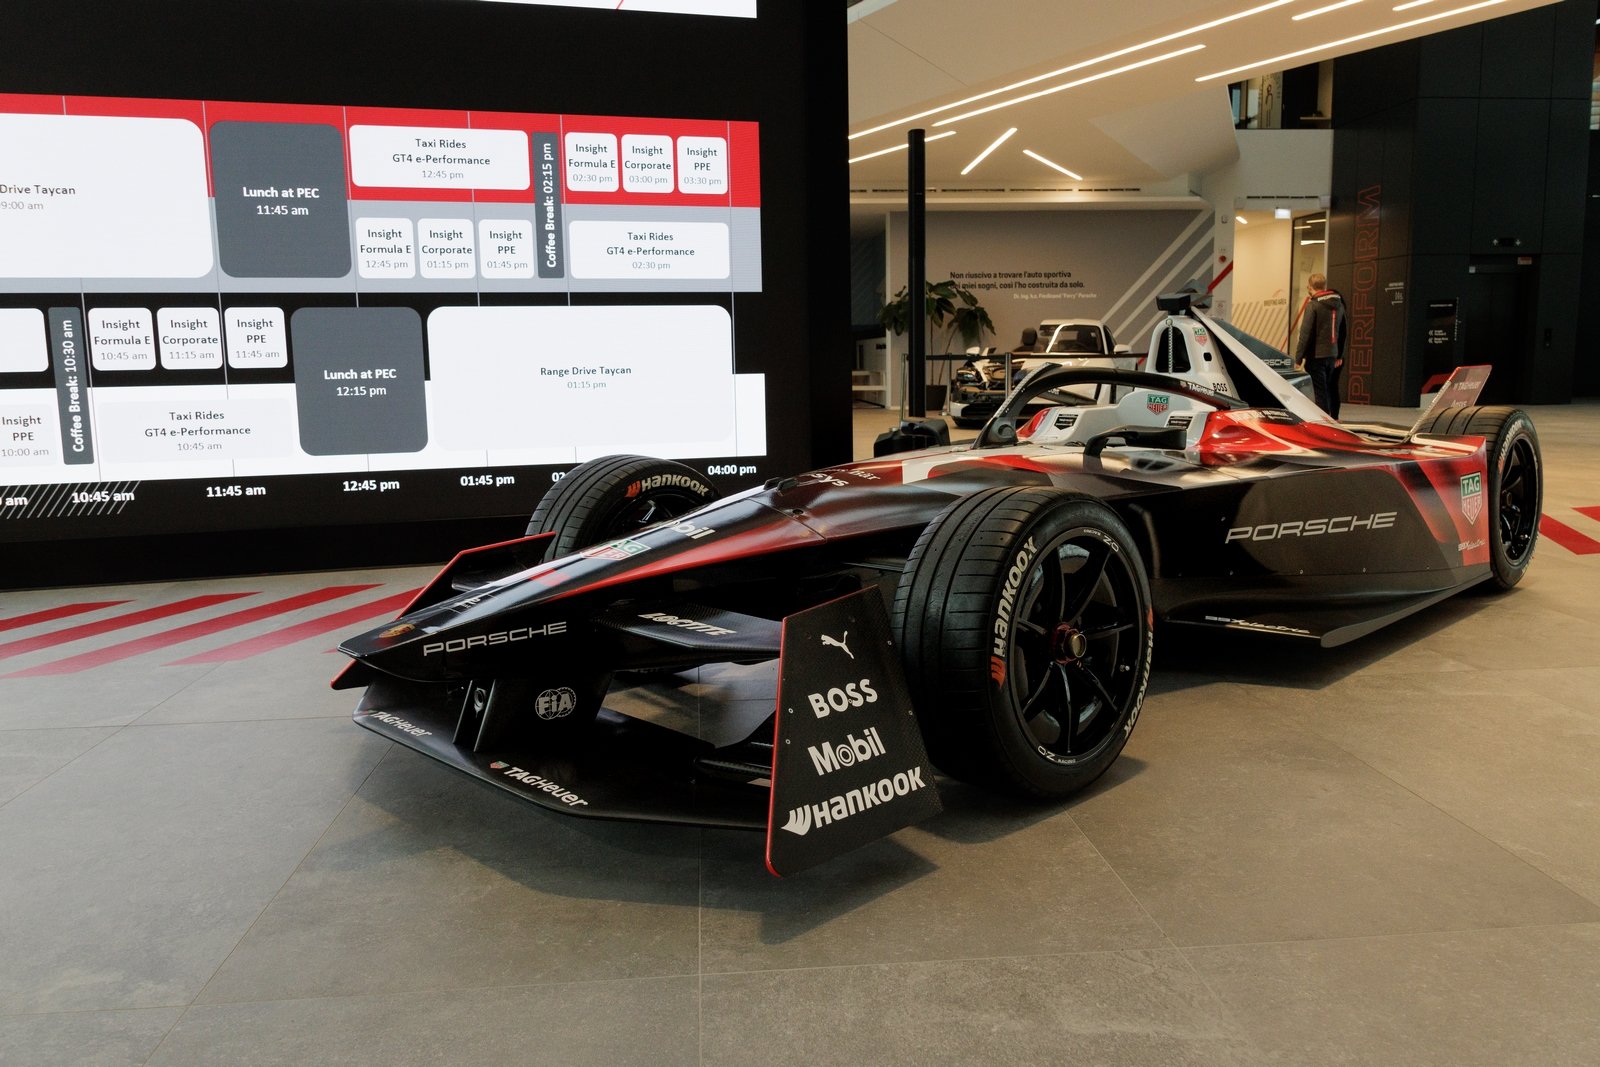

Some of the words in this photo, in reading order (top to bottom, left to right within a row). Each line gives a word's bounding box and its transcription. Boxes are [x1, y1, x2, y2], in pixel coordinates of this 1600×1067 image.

[416, 139, 436, 147] Taxi
[440, 140, 466, 148] Rides
[544, 143, 552, 160] pm
[576, 144, 607, 154] Insight
[633, 146, 663, 156] Insight
[687, 148, 717, 158] Insight
[393, 154, 412, 162] GT4
[416, 155, 490, 164] e-Performance
[569, 159, 607, 168] Formula
[611, 160, 615, 168] E
[625, 161, 671, 171] Corporate
[542, 164, 553, 193] 02:15
[0, 185, 30, 194] Drive
[33, 184, 76, 197] Taycan
[243, 187, 278, 197] Lunch
[282, 188, 294, 197] at
[297, 188, 319, 198] PEC
[257, 205, 288, 215] 11:45
[544, 196, 555, 230] Break:
[368, 229, 401, 240] Insight
[430, 230, 463, 240] Insight
[490, 231, 521, 241] Insight
[628, 232, 646, 240] Taxi
[361, 245, 402, 253] Formula
[406, 245, 411, 253] E
[422, 246, 472, 255] Corporate
[498, 246, 515, 254] PPE
[546, 230, 556, 267] Coffee
[607, 247, 624, 255] GT4
[628, 247, 694, 255] e-Performance
[655, 262, 670, 270] pm
[1043, 271, 1072, 279] sportiva
[1027, 281, 1058, 289] costruita
[1059, 281, 1068, 289] da
[1348, 184, 1381, 406] PERFORM
[63, 320, 73, 338] am
[102, 320, 140, 331] Insight
[171, 319, 207, 330] Insight
[237, 319, 273, 330] Insight
[94, 336, 141, 345] Formula
[146, 336, 150, 344] E
[163, 336, 218, 346] Corporate
[247, 335, 265, 343] PPE
[63, 341, 76, 372] 10:30
[101, 352, 128, 360] 10:45
[236, 350, 261, 358] 11:45
[324, 369, 357, 379] Lunch
[361, 370, 372, 379] at
[375, 369, 396, 378] PEC
[541, 368, 569, 377] Range
[600, 367, 631, 376] Taycan
[68, 376, 80, 412] Break:
[337, 386, 366, 396] 12:15
[370, 388, 386, 397] pm
[1150, 396, 1167, 404] TAG
[170, 412, 191, 420] Taxi
[195, 411, 224, 419] Rides
[2, 415, 42, 427] Insight
[12, 432, 34, 441] PPE
[71, 415, 84, 452] Coffee
[145, 428, 166, 437] GT4
[170, 427, 250, 436] e-Performance
[708, 465, 736, 475] 04:00
[737, 465, 756, 476] pm
[460, 475, 493, 486] 01:45
[496, 476, 514, 486] pm
[1462, 476, 1480, 495] TAG
[343, 480, 377, 491] 12:45
[380, 481, 399, 492] pm
[207, 486, 242, 497] 11:45
[246, 487, 266, 495] am
[5, 497, 28, 506] am
[71, 491, 107, 503] 10:45
[113, 491, 135, 502] am
[1225, 511, 1397, 544] PORSCHE
[423, 621, 567, 656] PORSCHE
[807, 678, 878, 720] BOSS
[807, 726, 886, 777] Mobil
